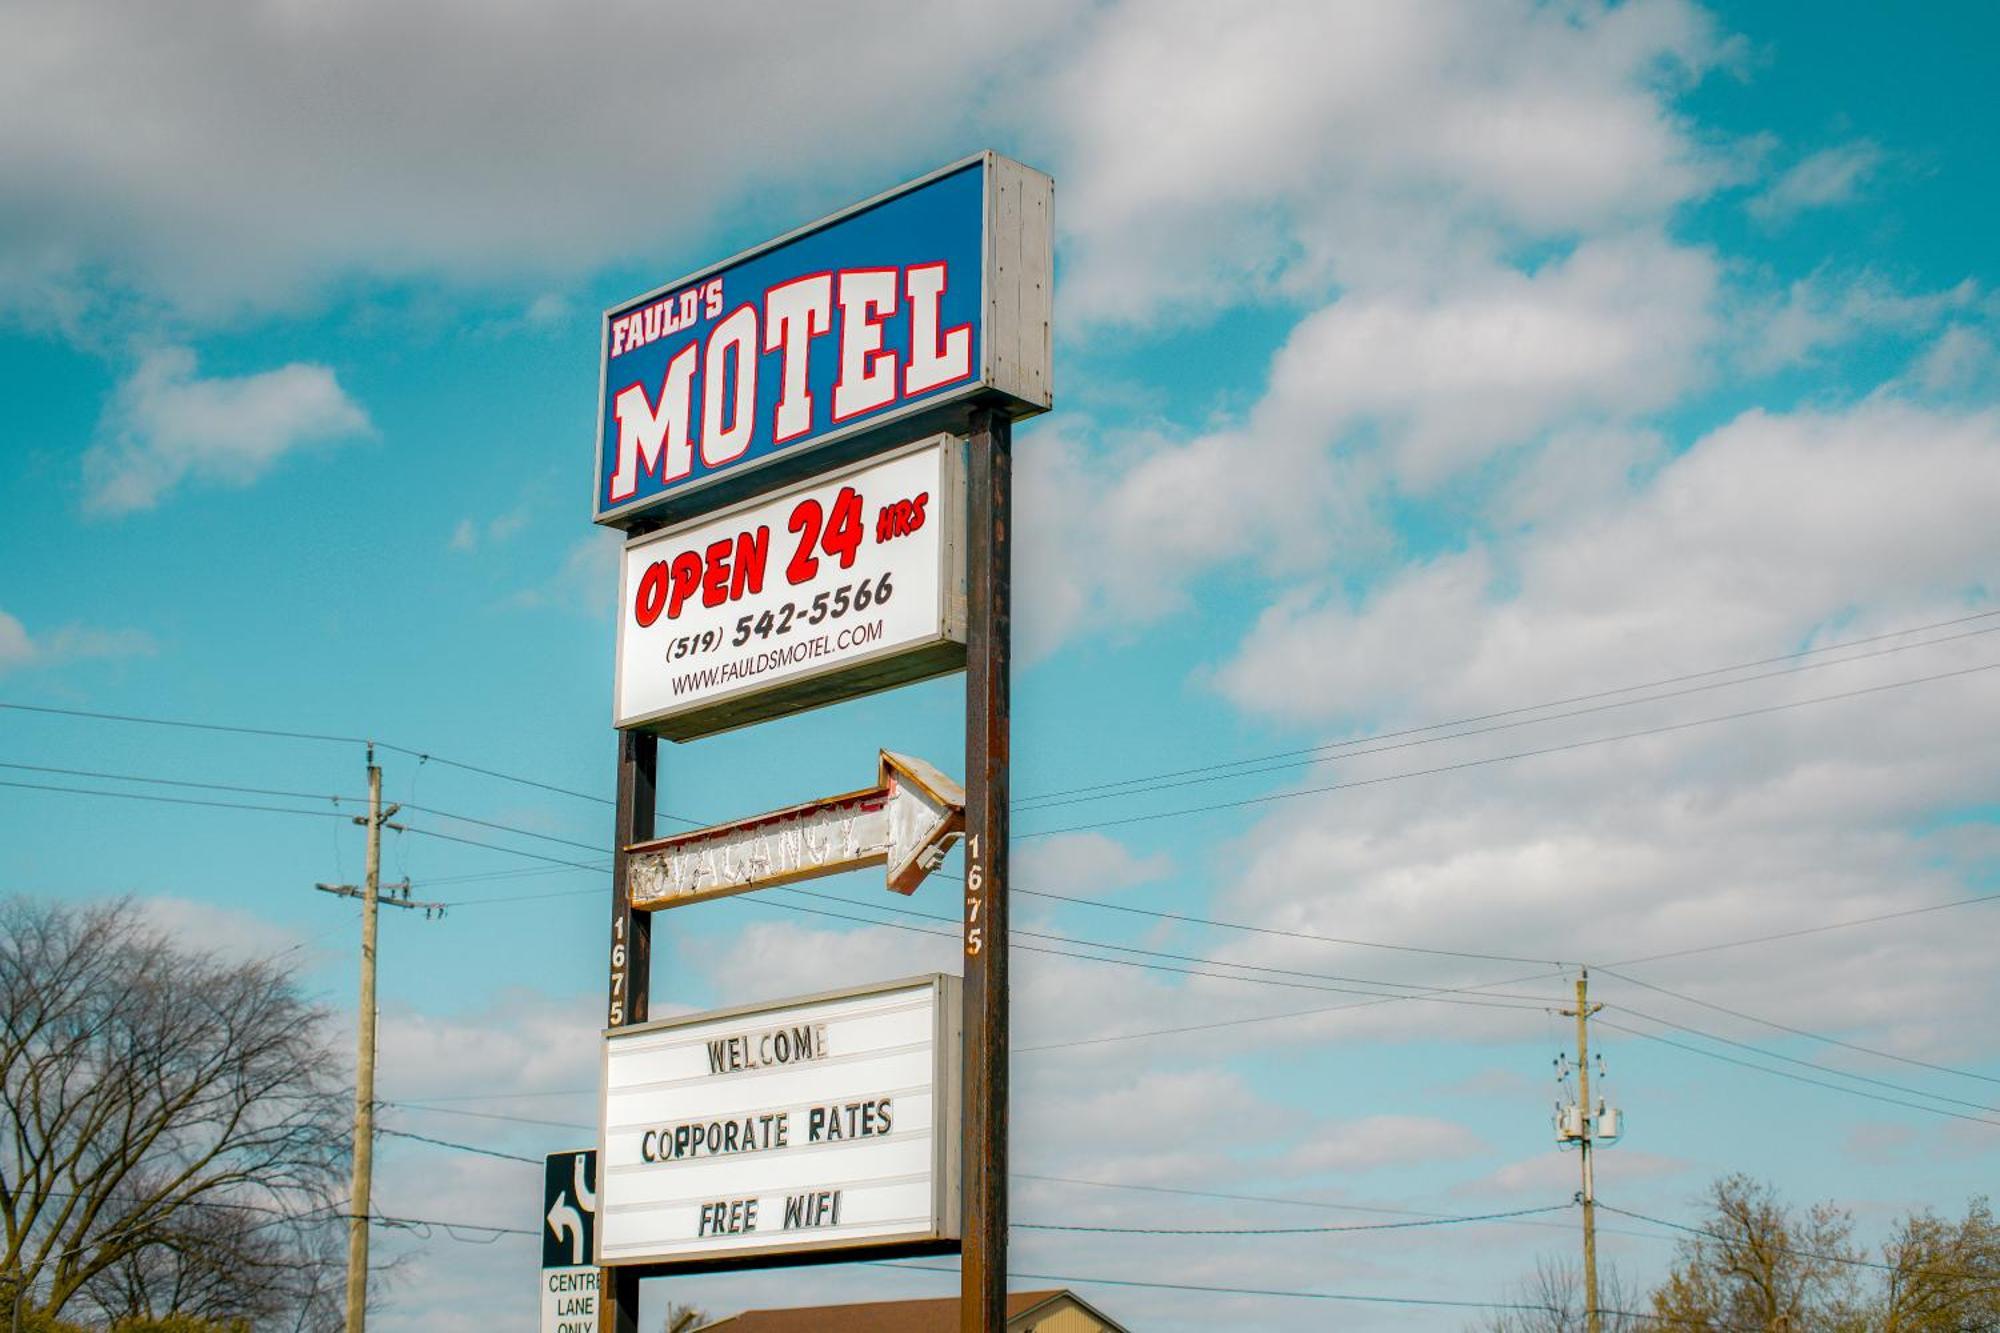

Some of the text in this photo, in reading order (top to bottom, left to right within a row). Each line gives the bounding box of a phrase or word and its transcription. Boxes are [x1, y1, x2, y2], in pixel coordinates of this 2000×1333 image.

[611, 277, 724, 358] FAULD'S
[610, 260, 972, 503] MOTEL
[635, 487, 929, 628] OPEN 24 HRS
[666, 572, 894, 663] (519) 542-5566
[672, 619, 884, 696] WWW.FAULDSMOTEL.COM
[967, 834, 982, 954] 1675
[610, 916, 625, 1025] 1675
[707, 1024, 828, 1074] WELCOME
[642, 1098, 892, 1163] CORPORATE RATES
[698, 1190, 841, 1237] FREE WIFI
[558, 1297, 593, 1316] LANE
